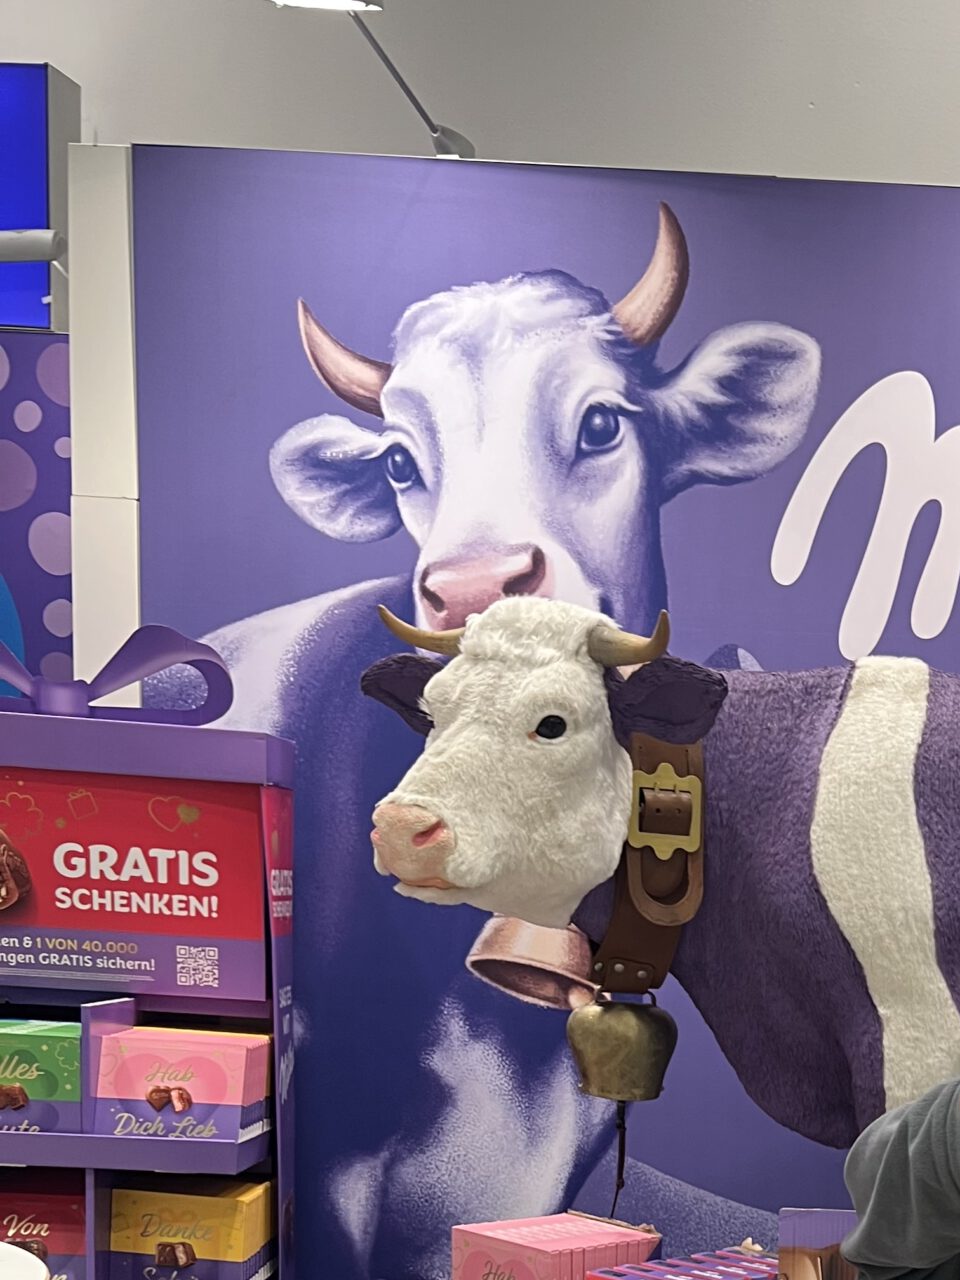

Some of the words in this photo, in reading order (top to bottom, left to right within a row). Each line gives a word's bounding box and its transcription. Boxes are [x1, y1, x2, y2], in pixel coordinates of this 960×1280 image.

[53, 842, 219, 887] GRATIS
[55, 887, 219, 919] SCHENKEN!
[23, 936, 33, 948] &
[36, 937, 42, 949] 1
[45, 938, 78, 951] VON
[82, 940, 138, 954] 40.000
[39, 953, 93, 967] GRATIS
[96, 957, 156, 971] sichern!
[0, 1055, 44, 1080] lles
[145, 1062, 198, 1083] Hab
[114, 1113, 165, 1138] Dich
[168, 1116, 219, 1140] Lieb
[3, 1214, 50, 1238] Von
[140, 1213, 215, 1241] Danke
